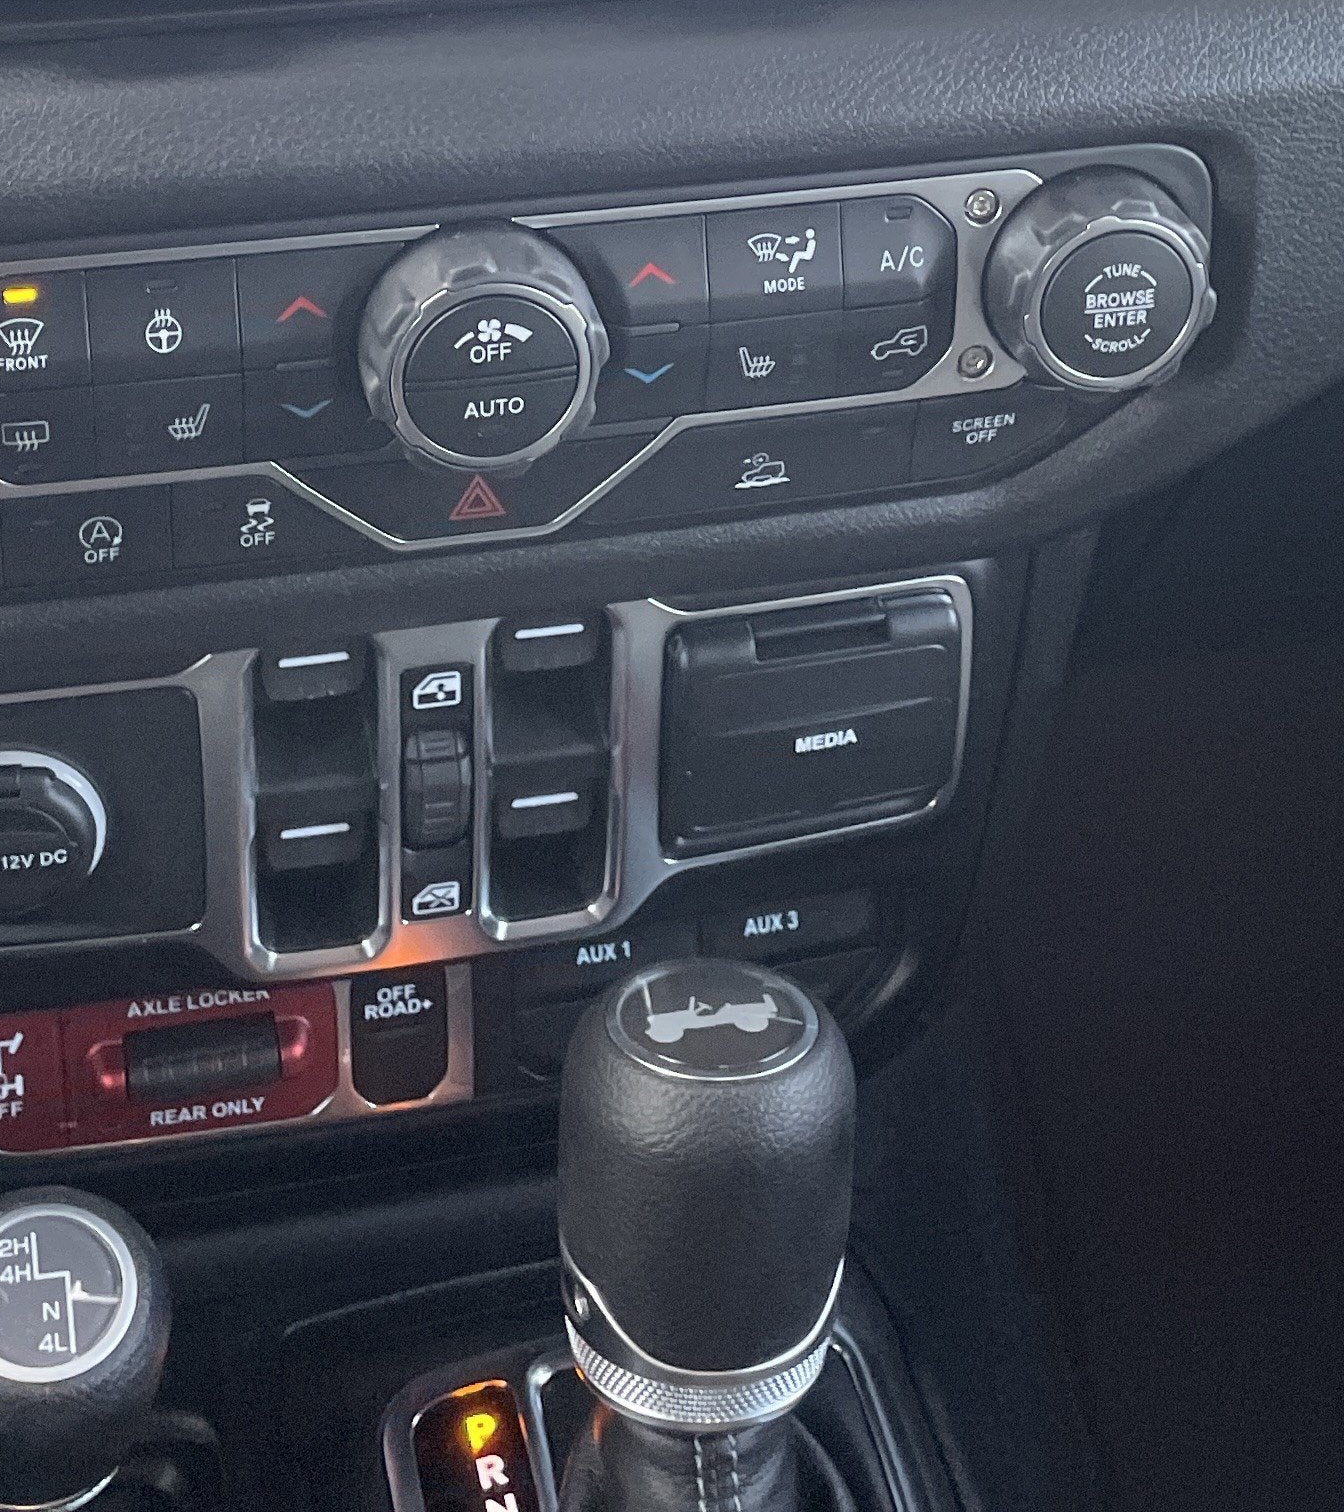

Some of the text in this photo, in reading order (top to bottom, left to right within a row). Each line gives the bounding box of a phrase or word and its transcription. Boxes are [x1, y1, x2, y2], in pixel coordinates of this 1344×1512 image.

[879, 246, 924, 272] A/C
[1102, 263, 1143, 279] TUNE
[763, 276, 806, 294] MODE
[1085, 288, 1155, 309] BROWSE
[1093, 309, 1147, 329] ENTER
[469, 342, 512, 364] OFF
[1092, 334, 1145, 353] SCROLL
[464, 396, 525, 419] AUTO
[952, 412, 1016, 434] SCREEN
[966, 427, 998, 445] OFF
[239, 530, 276, 548] OFF
[84, 546, 121, 564] OFF
[794, 728, 858, 754] MEDIA
[0, 852, 34, 870] 12V
[743, 911, 799, 937] AUX 3
[576, 941, 631, 965] AUX 1
[127, 989, 271, 1019] AXLE LOCKER
[376, 984, 417, 1003] OFF
[149, 1096, 266, 1127] REAR ONLY
[0, 1262, 31, 1285] 4H
[42, 1300, 61, 1322] N
[38, 1332, 68, 1353] 4L
[465, 1413, 496, 1453] P
[475, 1454, 510, 1491] R
